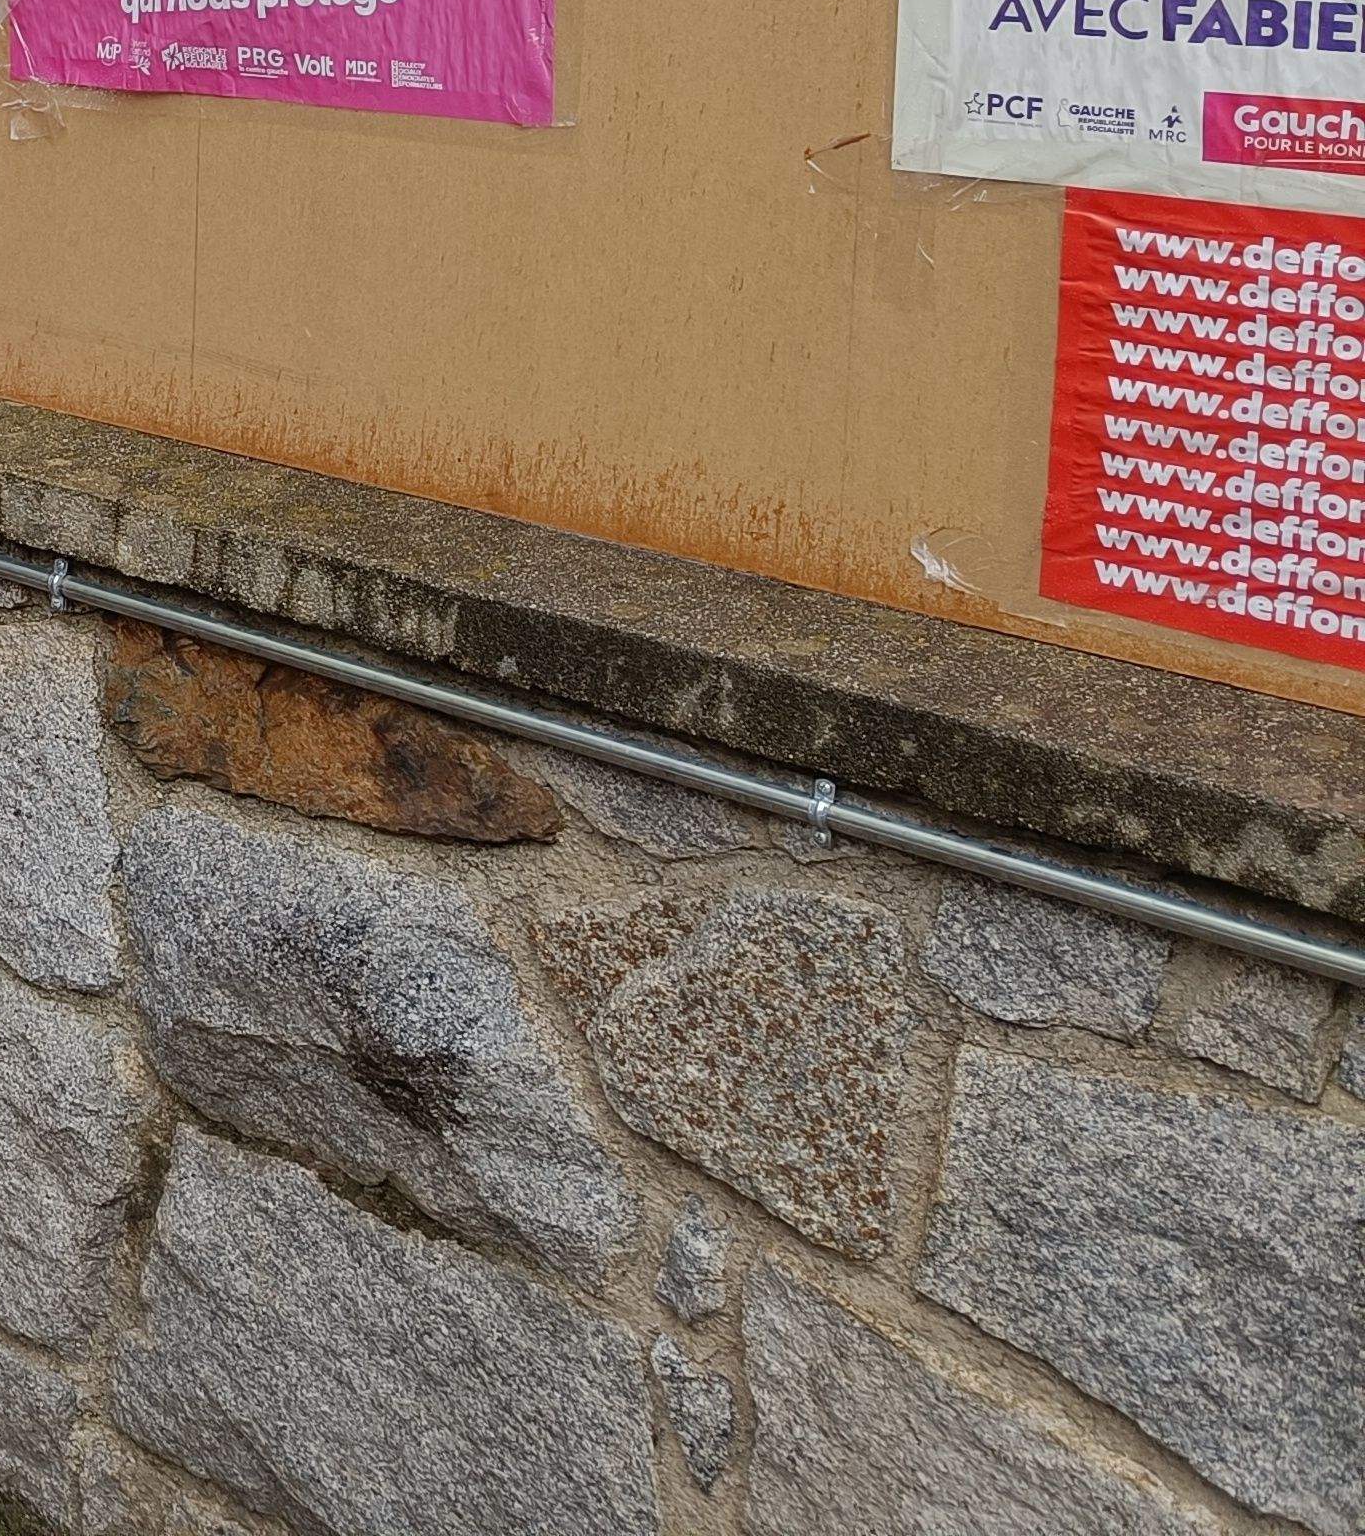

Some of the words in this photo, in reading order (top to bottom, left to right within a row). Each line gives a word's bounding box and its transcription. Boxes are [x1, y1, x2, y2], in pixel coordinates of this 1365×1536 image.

[237, 46, 284, 66] PRG
[294, 52, 335, 77] Volt
[345, 59, 378, 76] MDC
[987, 93, 1043, 120] PCF
[1069, 104, 1135, 120] GAUCHE
[1149, 129, 1186, 143] MRC
[1244, 135, 1291, 152] POUR
[1295, 140, 1315, 154] LE
[1319, 143, 1365, 158] MON
[1113, 265, 1365, 322] www.deffo
[1111, 302, 1365, 361] www.deffo
[1109, 339, 1365, 400] www.deffo
[1107, 375, 1365, 443] www.deffo
